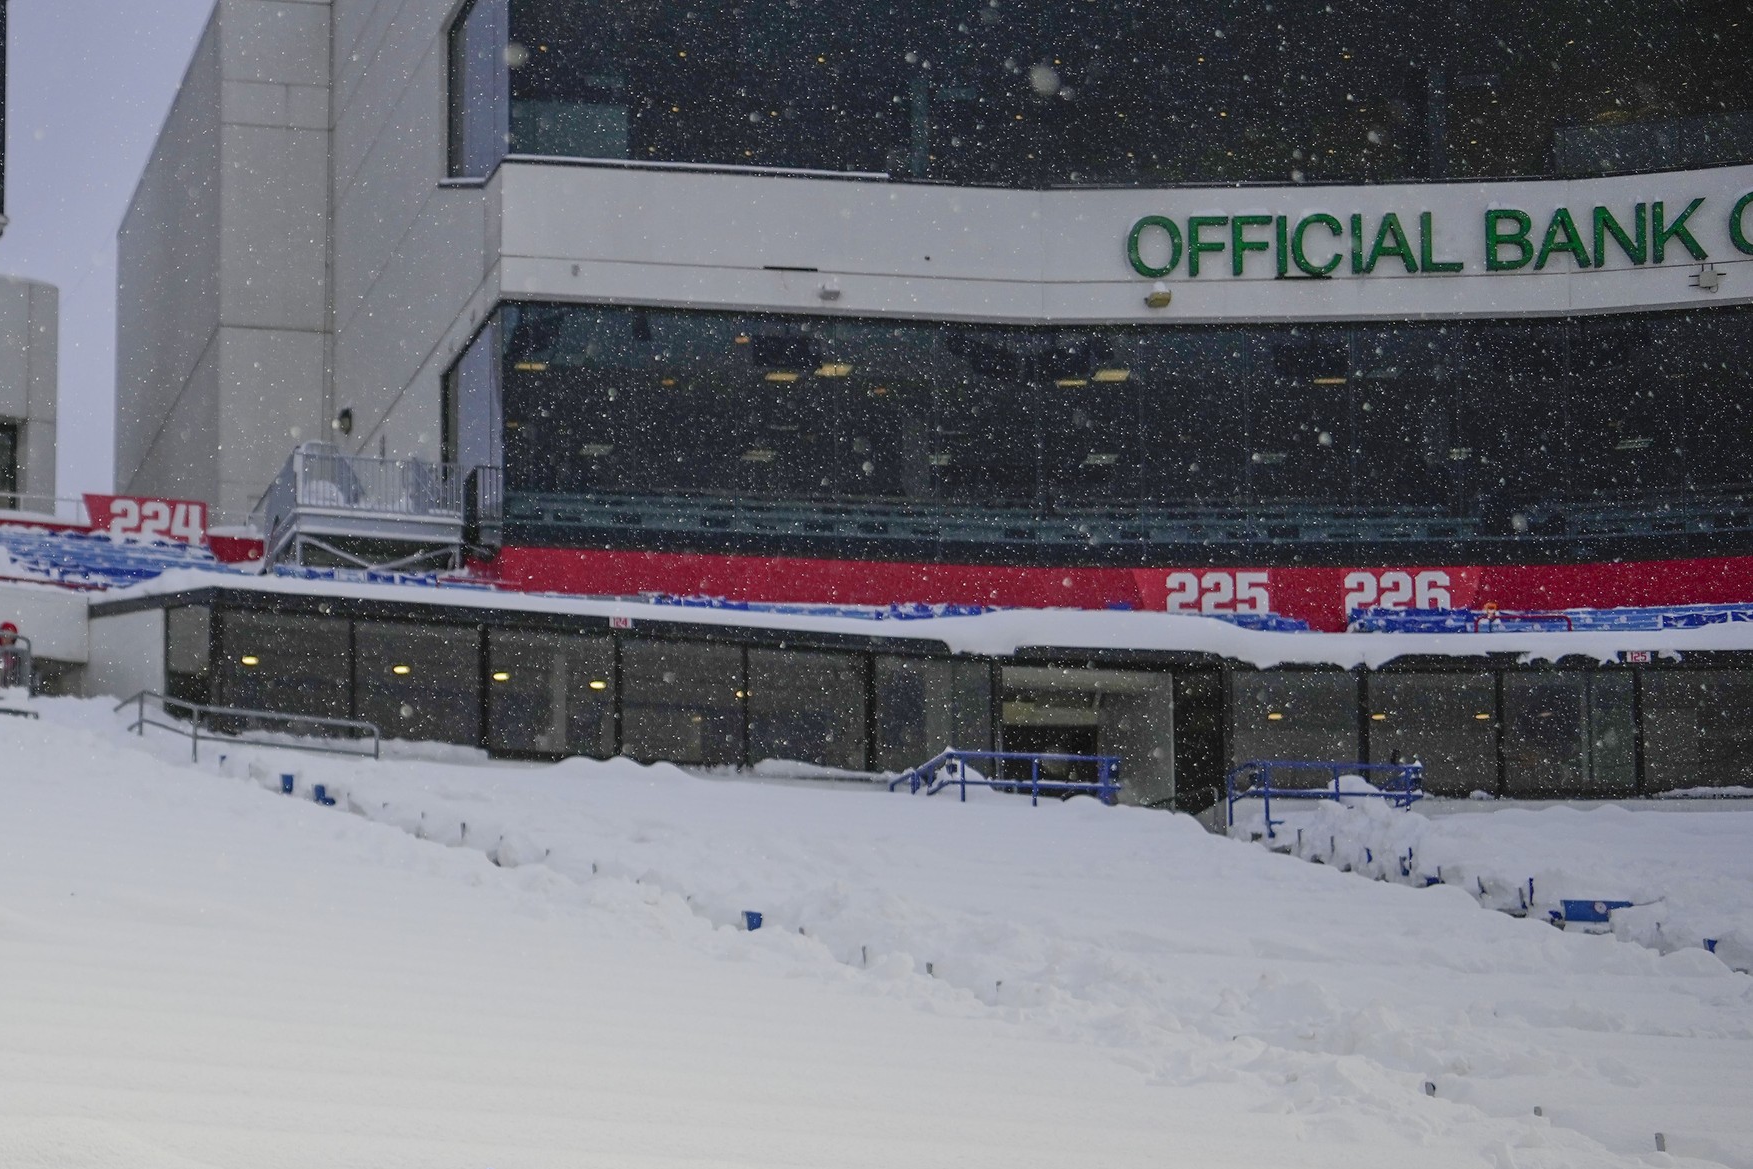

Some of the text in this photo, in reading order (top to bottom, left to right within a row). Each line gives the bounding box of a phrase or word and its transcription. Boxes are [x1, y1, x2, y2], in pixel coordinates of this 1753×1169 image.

[1126, 212, 1465, 278] OFFICIAL
[1485, 197, 1708, 272] BANK
[110, 499, 202, 546] 224
[1166, 572, 1270, 615] 225
[1344, 571, 1451, 611] 226
[1630, 651, 1648, 661] 125
